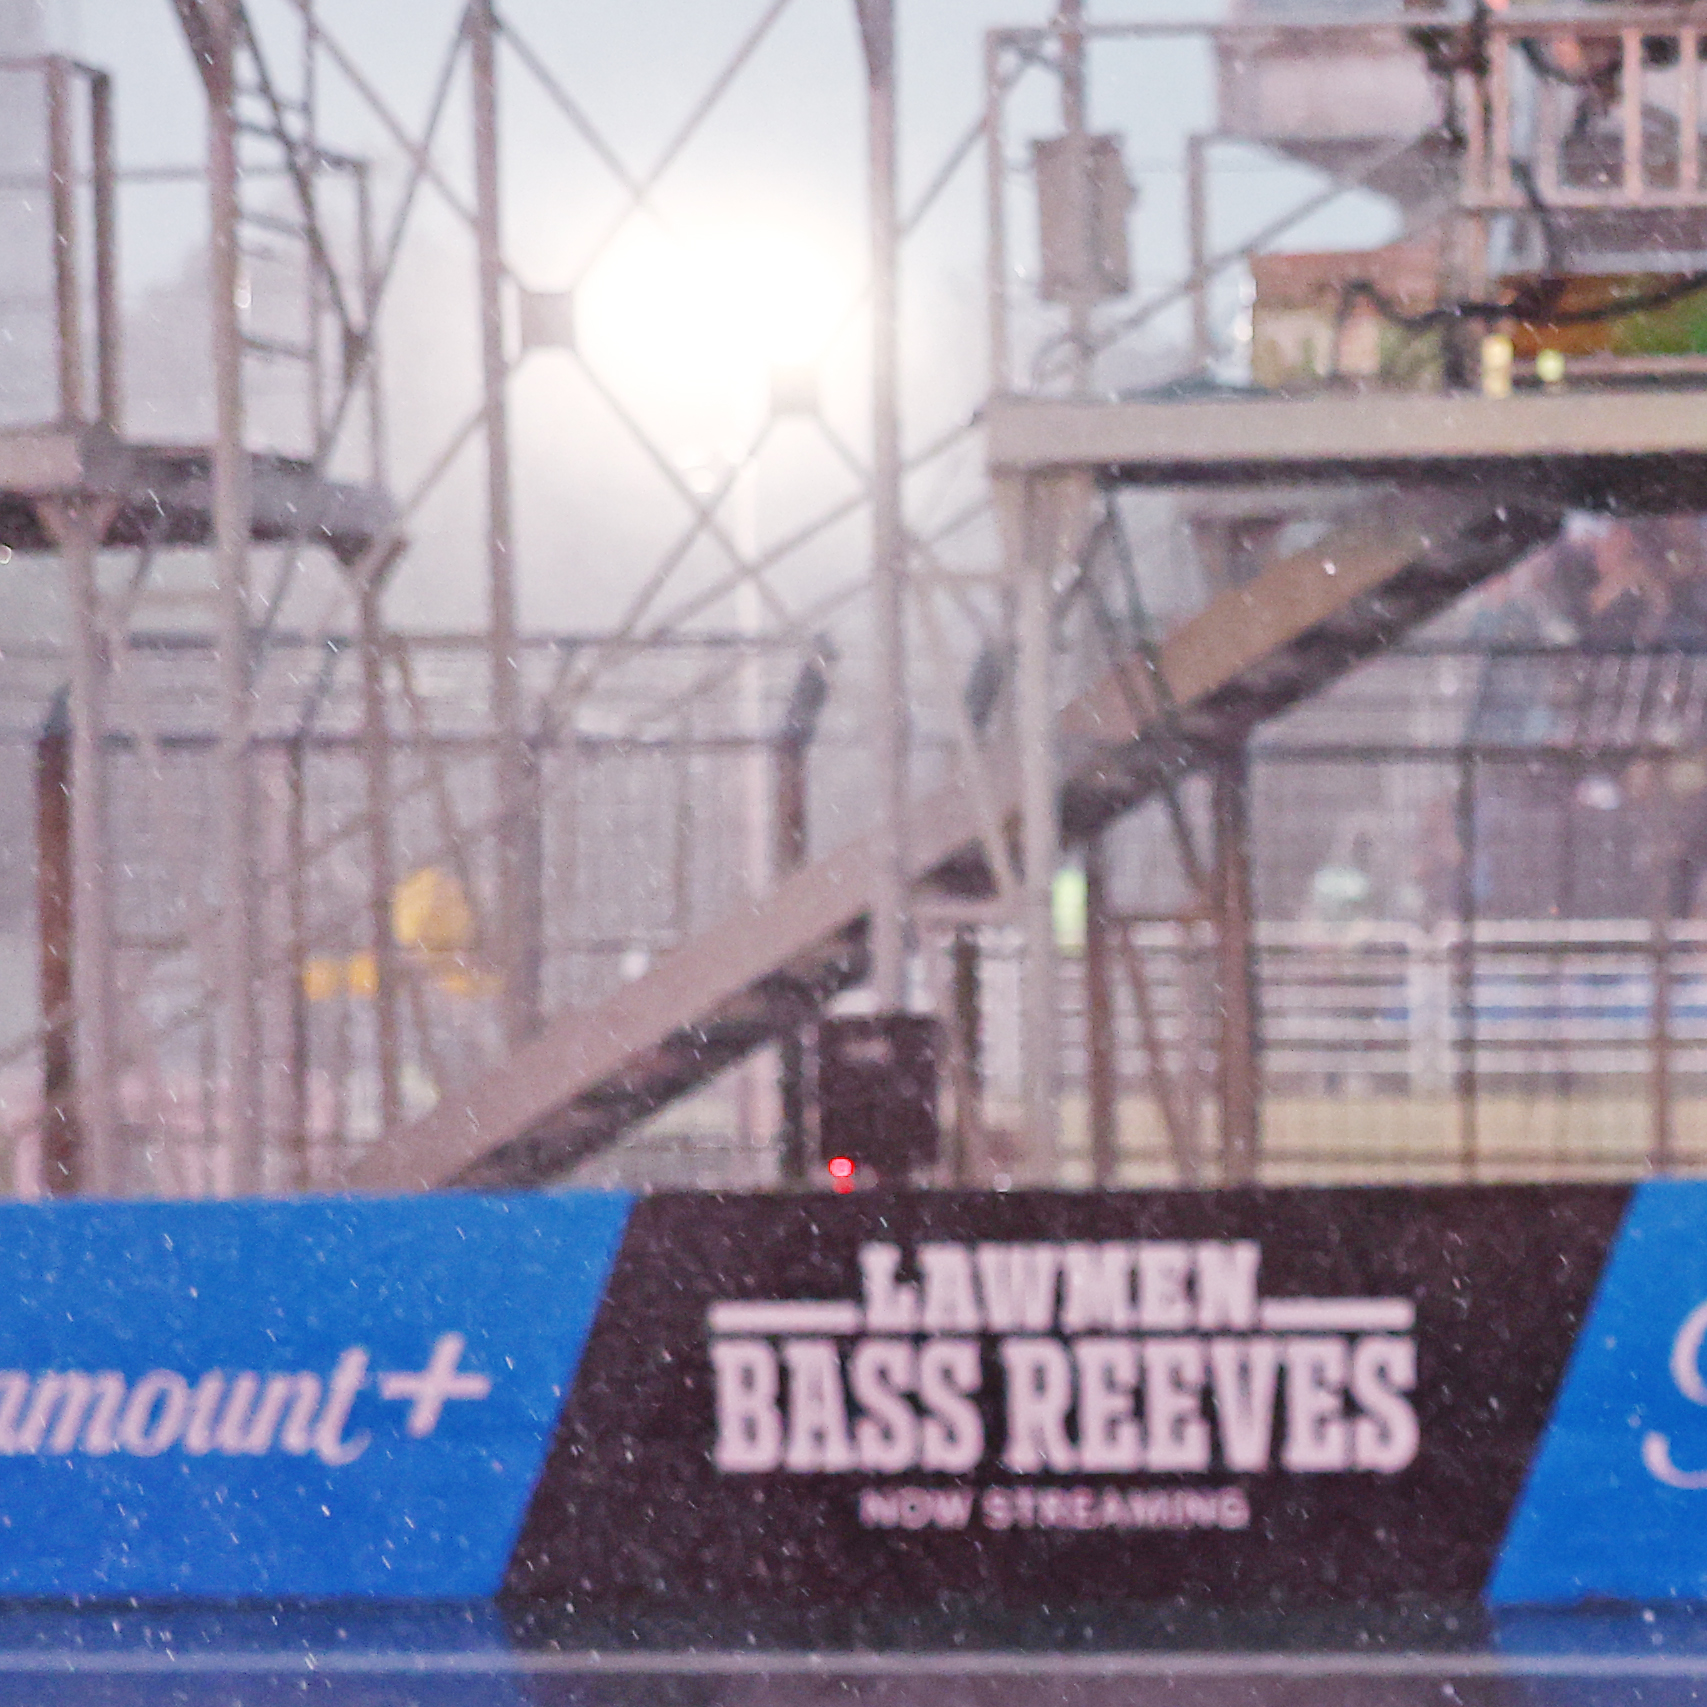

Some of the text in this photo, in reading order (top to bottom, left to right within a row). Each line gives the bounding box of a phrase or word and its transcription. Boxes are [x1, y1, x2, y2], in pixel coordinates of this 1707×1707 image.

[859, 1240, 1262, 1332] LAWMEN
[711, 1335, 1420, 1475] BASS REEVES
[859, 1484, 1252, 1531] NOW STREAMING
